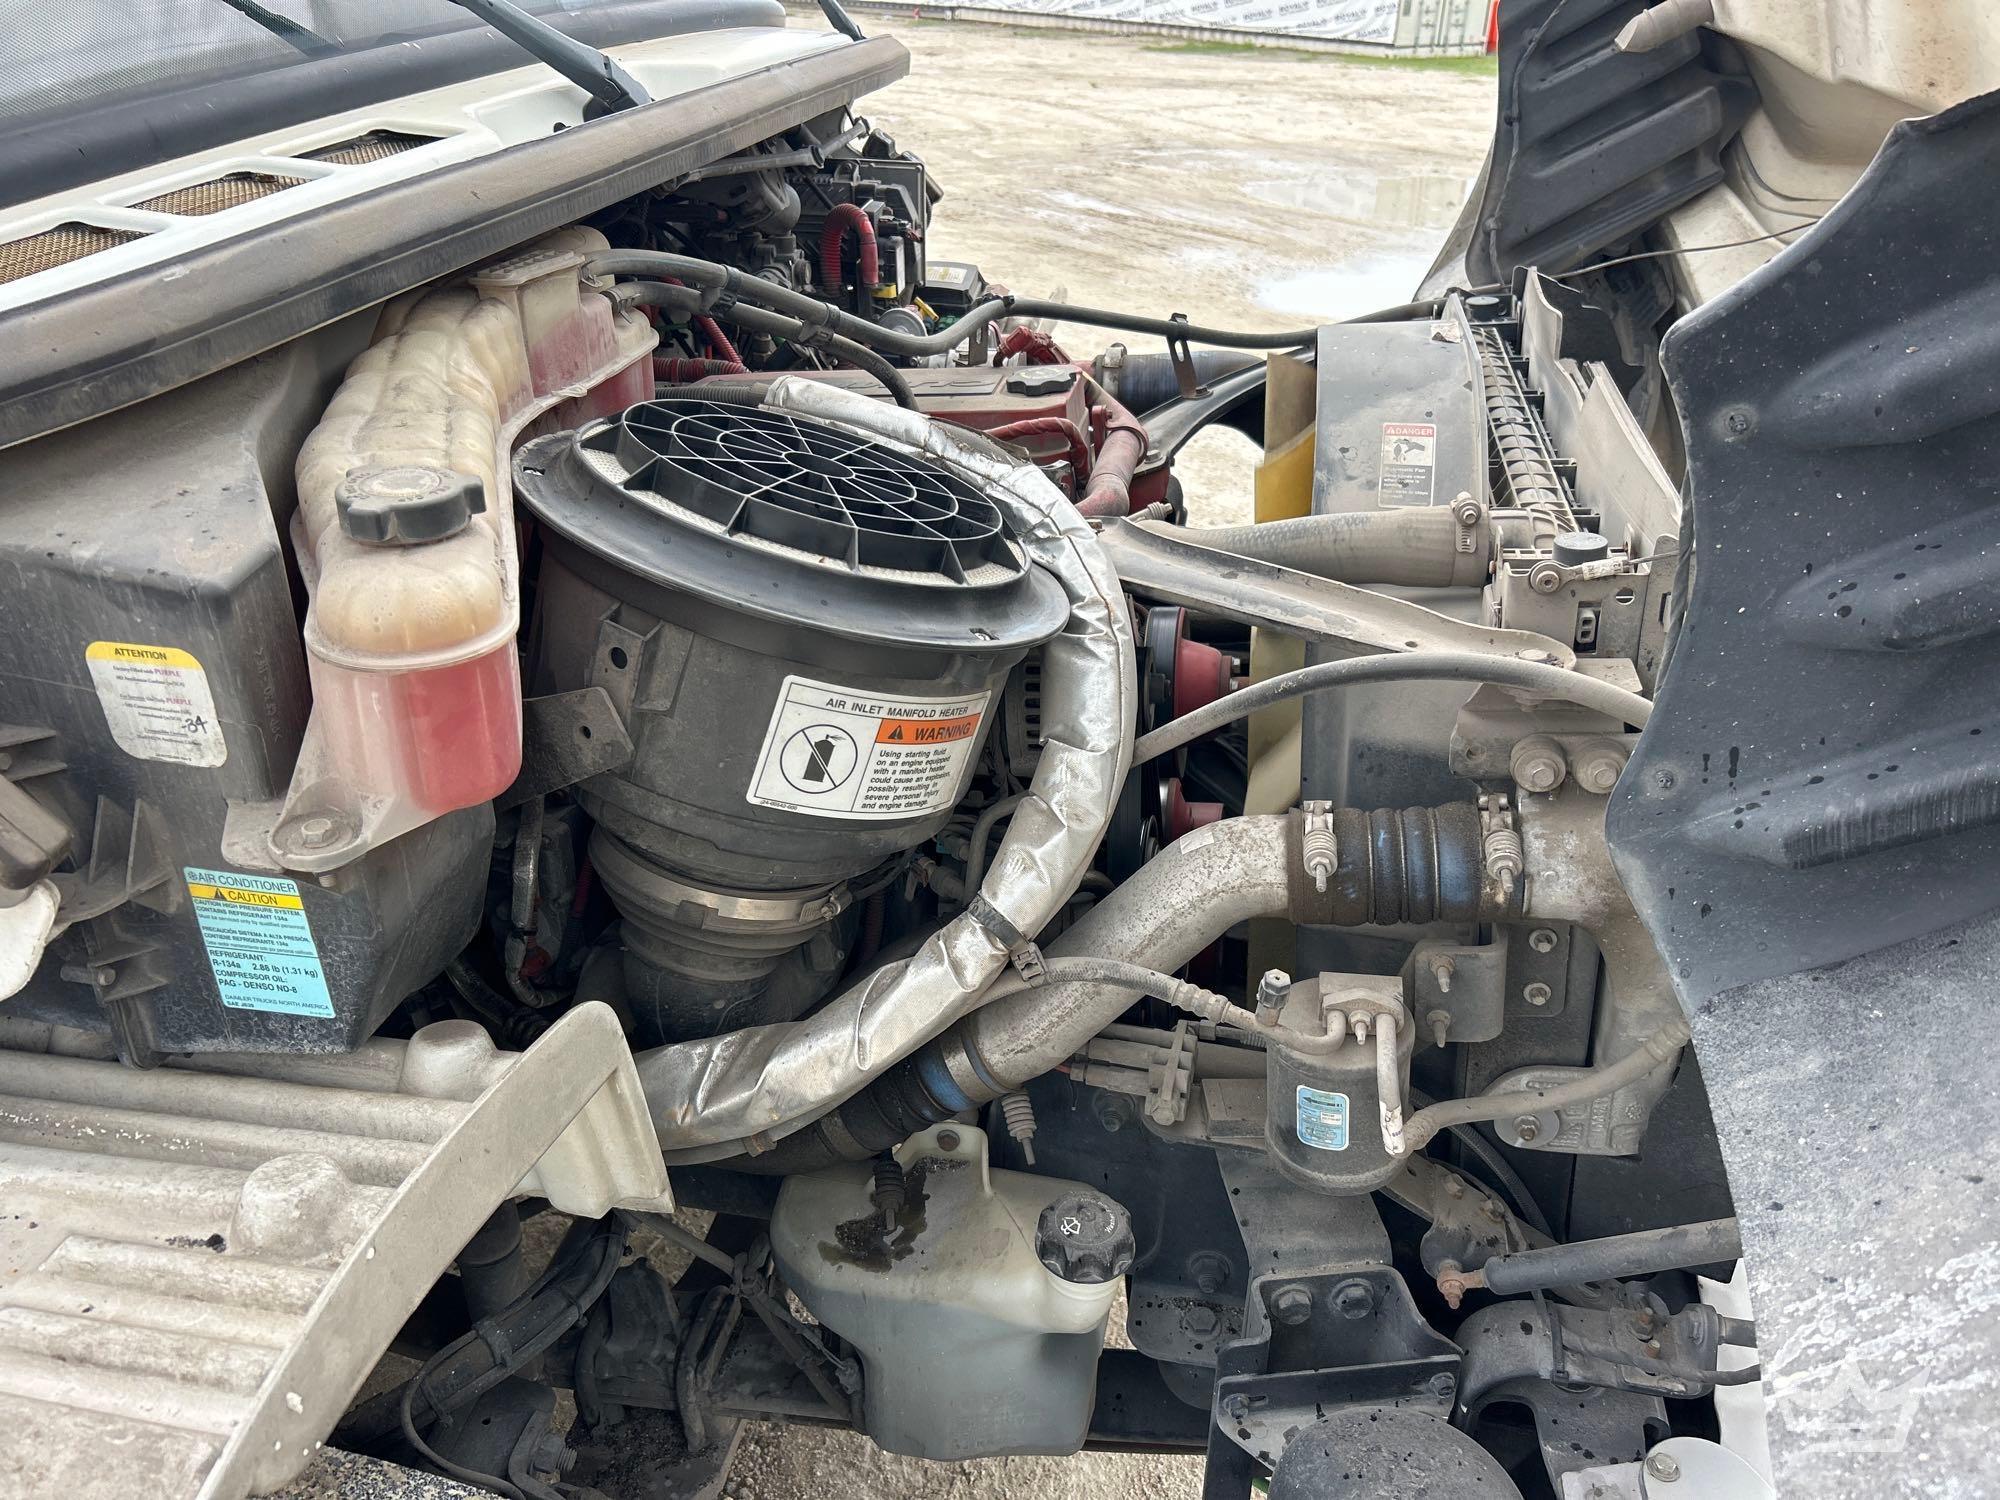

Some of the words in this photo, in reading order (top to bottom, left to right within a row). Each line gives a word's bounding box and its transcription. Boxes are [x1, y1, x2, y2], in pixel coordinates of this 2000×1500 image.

[114, 648, 168, 660] ATTENTION
[826, 698, 846, 710] AIR
[851, 702, 882, 715] INLET
[887, 706, 936, 718] MANIFOLD
[939, 706, 968, 717] HEATER
[915, 724, 970, 741] WARNING
[880, 750, 902, 759] Using
[905, 751, 930, 760] starting
[933, 748, 947, 756] fluid
[901, 760, 923, 768] engine
[925, 756, 951, 766] equipped
[899, 767, 927, 775] manifold
[867, 785, 899, 793] possibly
[902, 784, 930, 792] resulting
[892, 792, 921, 801] personal
[199, 872, 215, 883] AIR
[220, 875, 296, 893] CONDITIONER
[228, 890, 278, 906] CAUTION
[196, 906, 227, 915] CONTAINS
[228, 910, 272, 921] REFRIGERANT
[239, 904, 273, 913] PRESSURE
[210, 949, 266, 962] REFRIGERANT:
[212, 959, 241, 968] R-134a
[272, 964, 280, 972] lb
[282, 965, 301, 976] (1.31
[304, 967, 318, 978] kg)
[215, 969, 271, 981] COMPRESSOR
[218, 978, 236, 987] PAG
[243, 981, 275, 991] DENSO
[276, 985, 298, 993] ND-8
